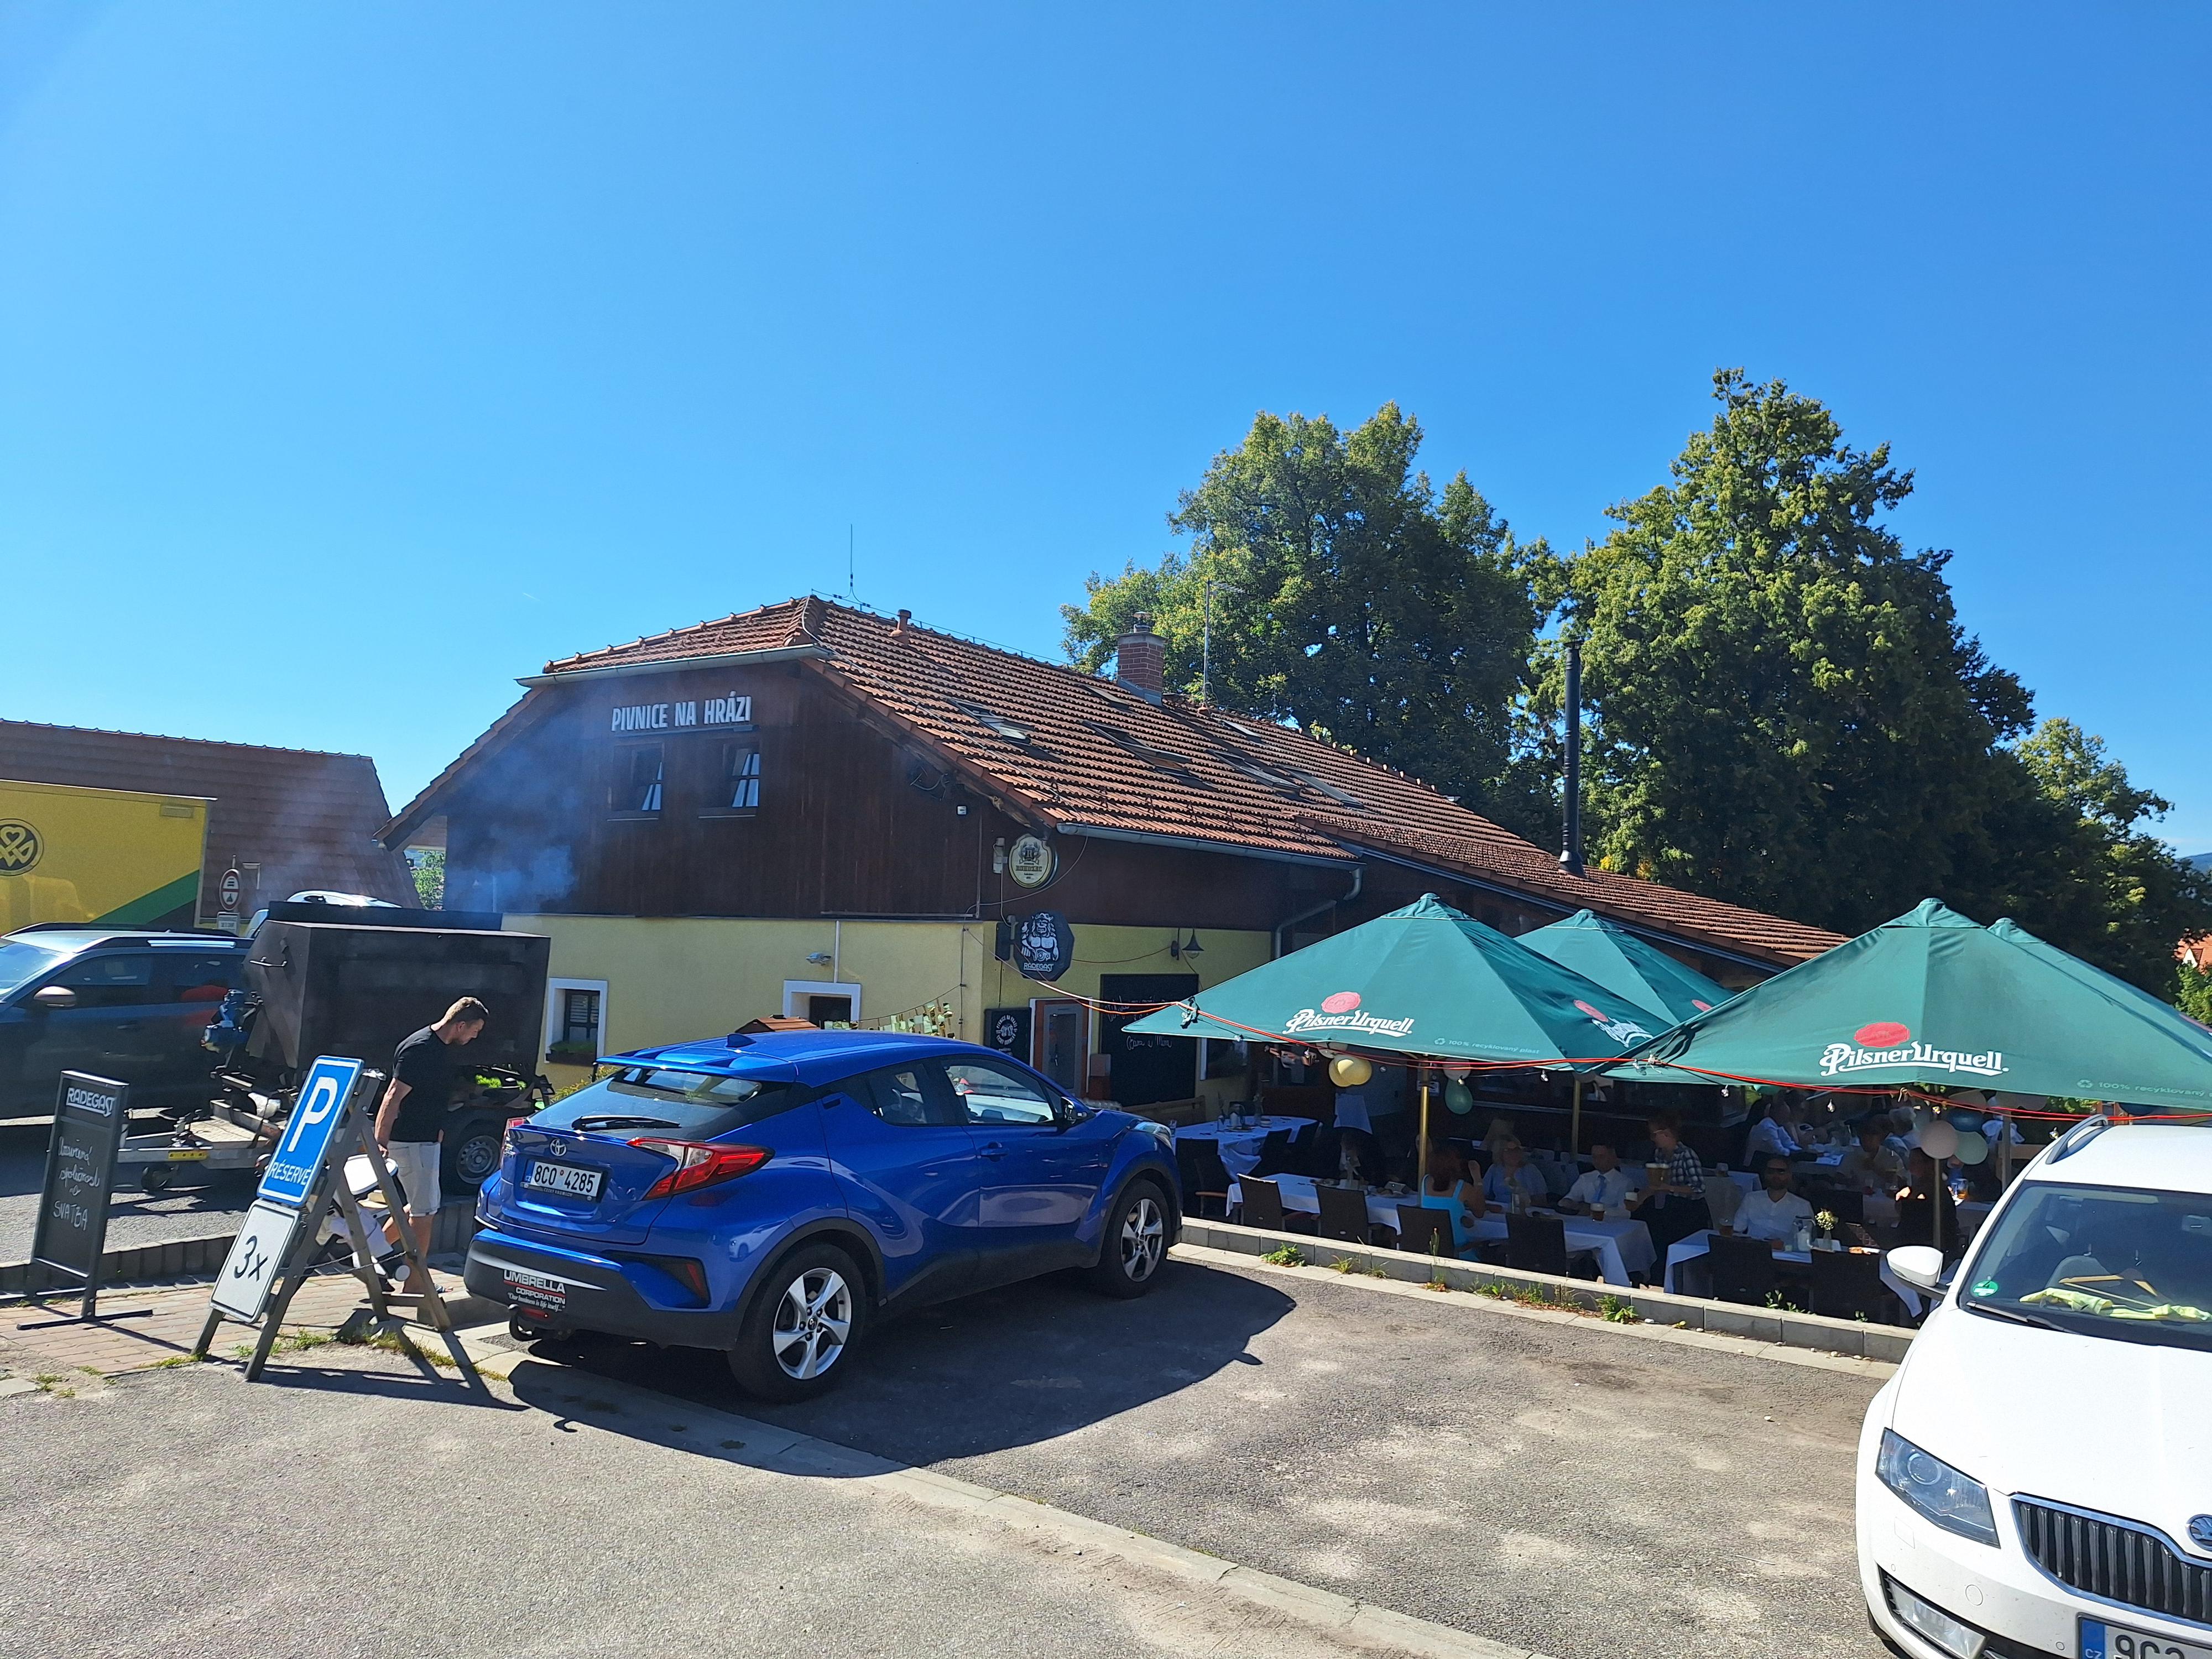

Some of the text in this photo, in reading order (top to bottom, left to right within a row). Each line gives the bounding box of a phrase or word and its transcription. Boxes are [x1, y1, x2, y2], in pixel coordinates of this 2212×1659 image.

[611, 690, 752, 732] PIVNICE NA HRÁZI
[1024, 962, 1054, 972] RADEGAST
[1282, 1008, 1354, 1035] Pilsner
[1472, 1042, 1519, 1053] recyklovaný
[1819, 1043, 1914, 1077] Pilsner
[66, 1087, 117, 1118] RADEGAST
[2099, 1082, 2130, 1090] 100%
[2135, 1085, 2205, 1097] recyklovaný
[286, 1076, 338, 1152] P
[268, 1159, 314, 1186] RÉSERVÉ
[564, 1170, 596, 1193] 4285
[233, 1235, 269, 1282] 3x
[504, 1269, 566, 1294] UMBRELLA
[515, 1286, 566, 1305] CORPORATION
